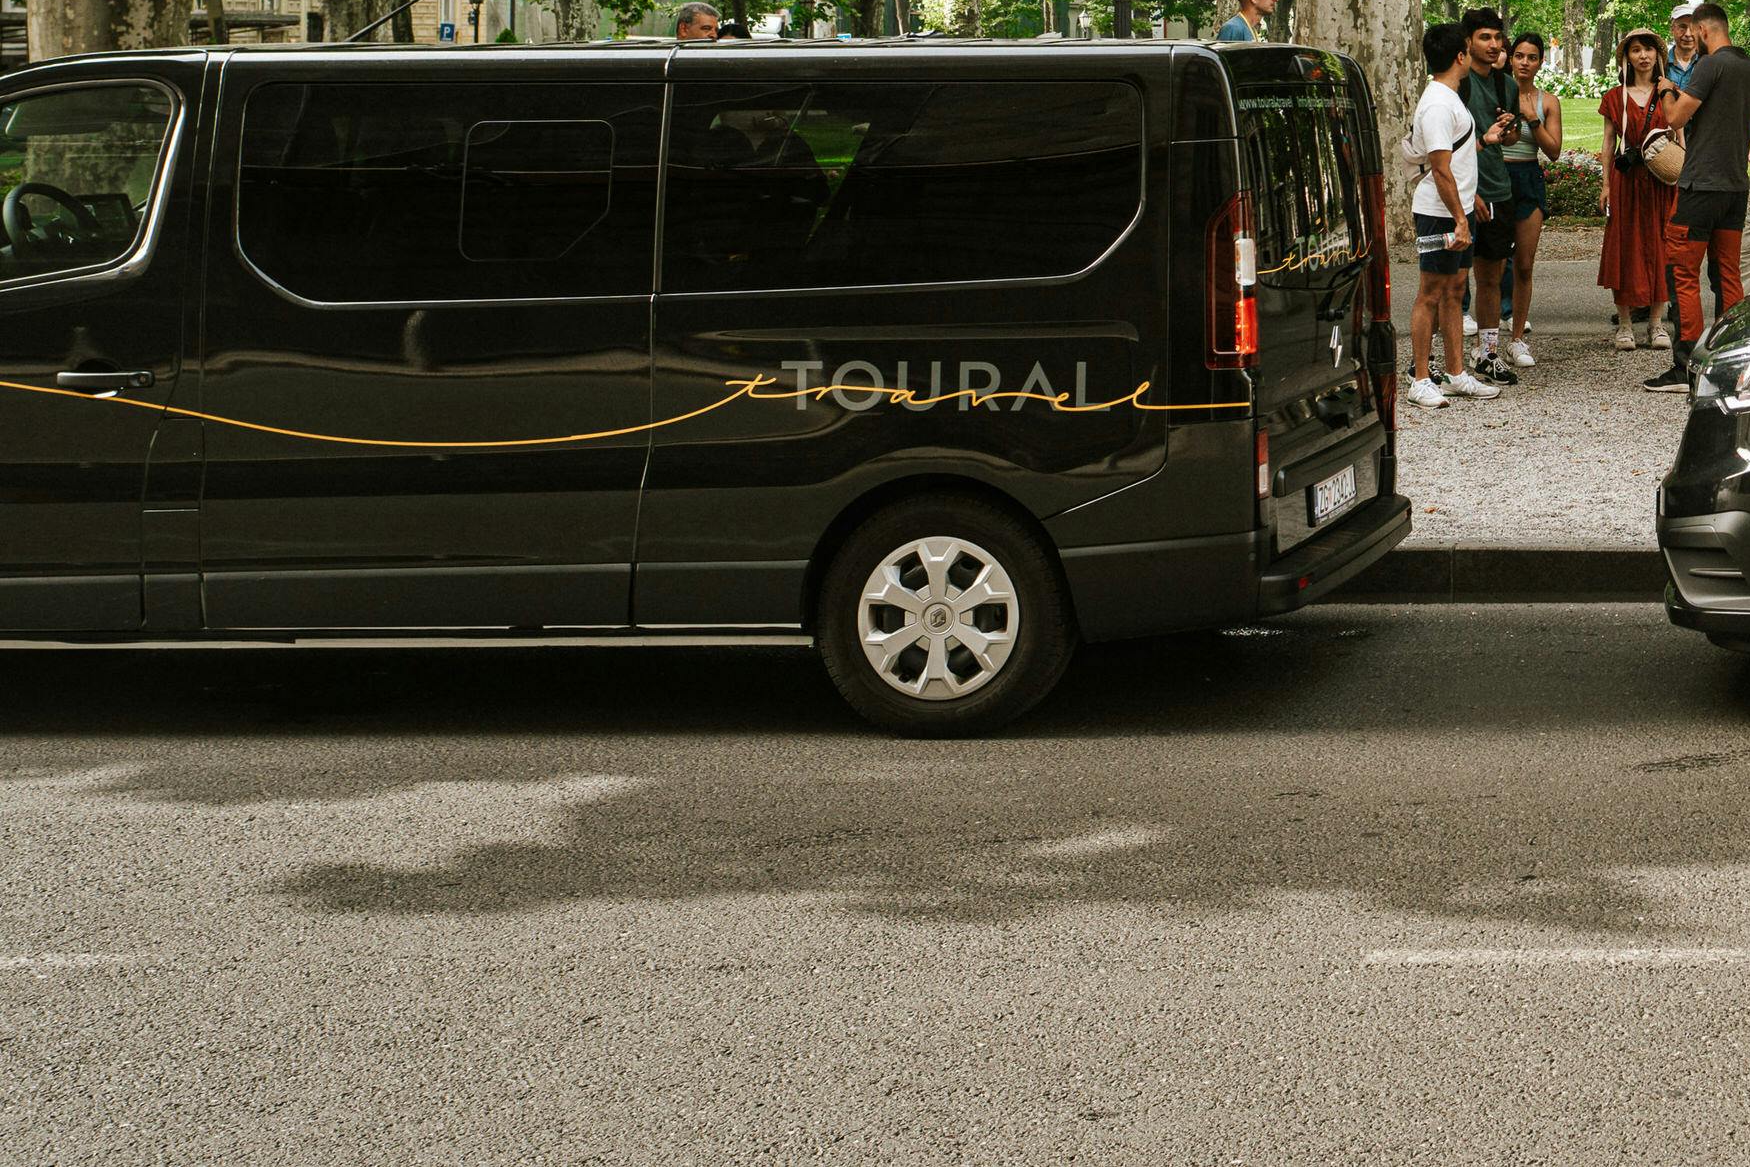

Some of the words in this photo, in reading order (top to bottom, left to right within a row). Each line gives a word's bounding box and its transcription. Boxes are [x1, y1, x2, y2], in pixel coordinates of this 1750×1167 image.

[443, 26, 451, 38] P
[724, 372, 1152, 413] travel
[781, 360, 1112, 413] TOURAL
